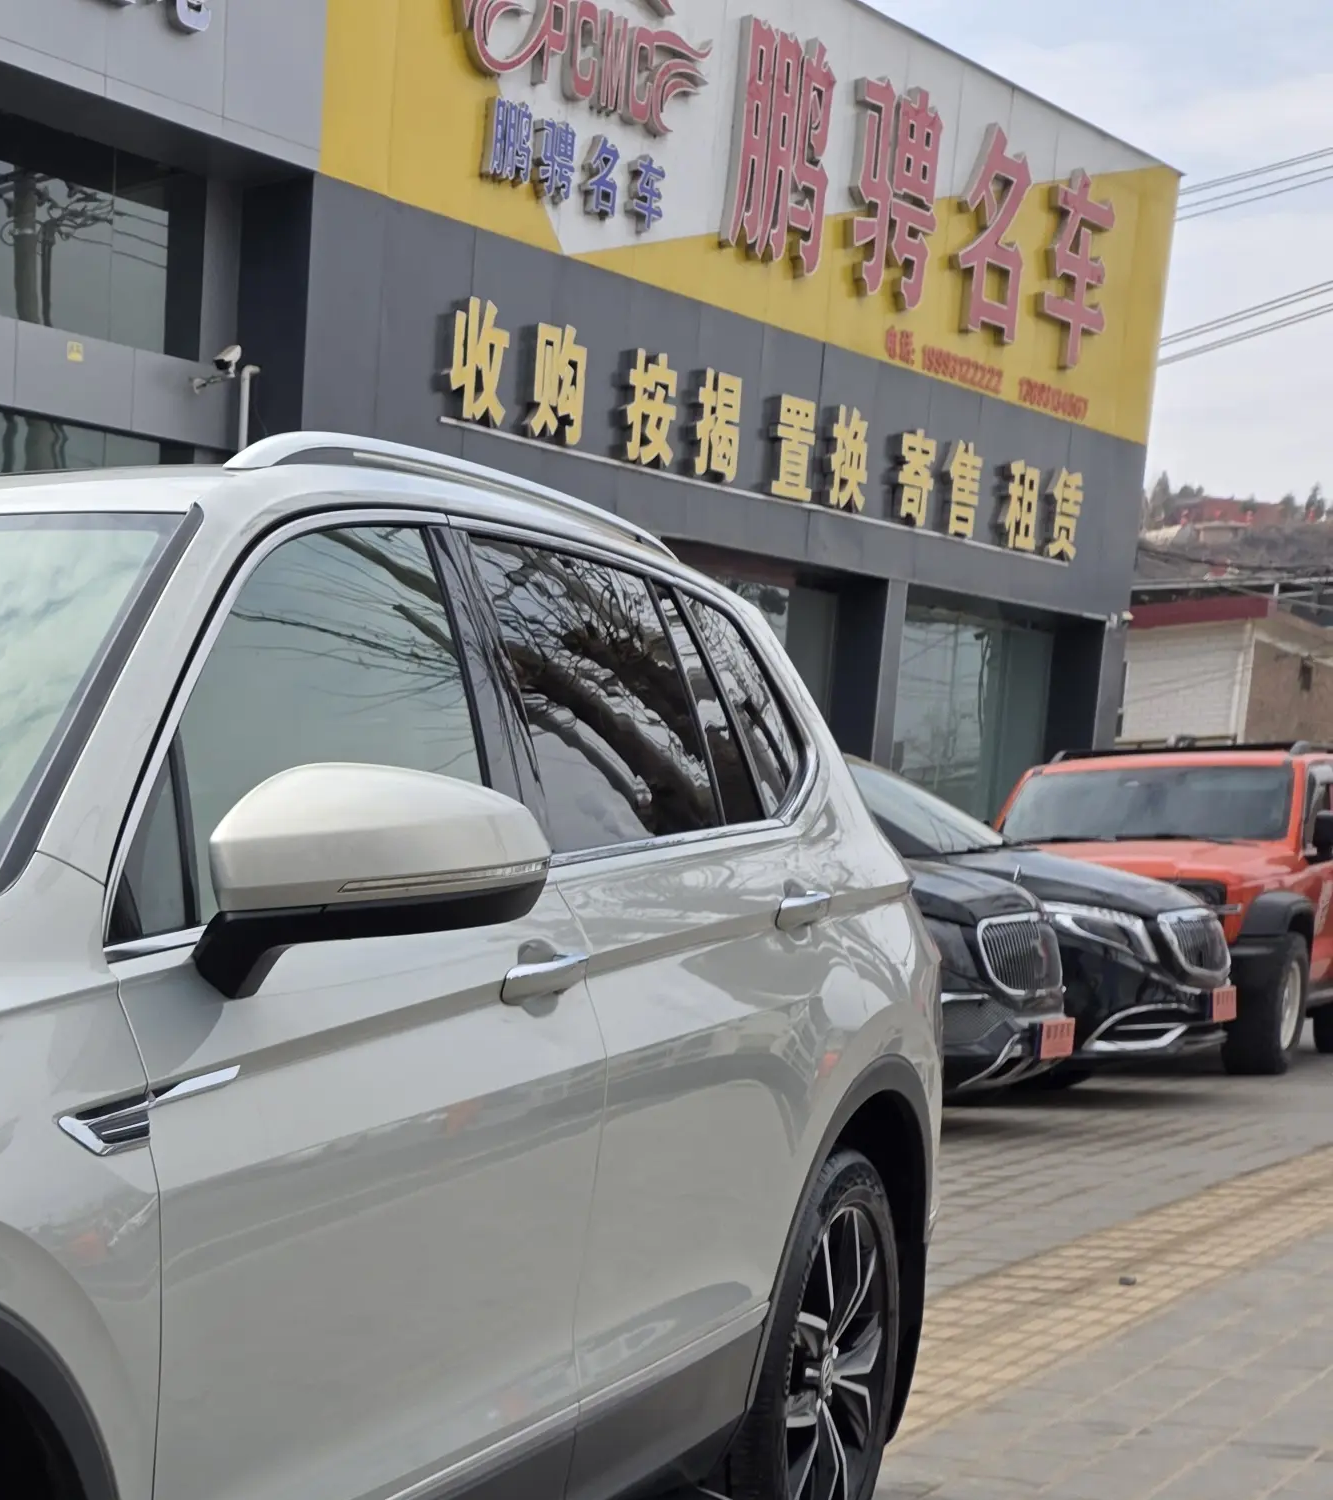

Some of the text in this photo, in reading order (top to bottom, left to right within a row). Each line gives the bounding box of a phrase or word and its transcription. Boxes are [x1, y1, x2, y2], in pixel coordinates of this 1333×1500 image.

[490, 98, 666, 230] 鹏骋名车
[729, 16, 1115, 368] 鹏骋名车
[450, 296, 1084, 562] 收购 按揭 置换 寄售 租赁
